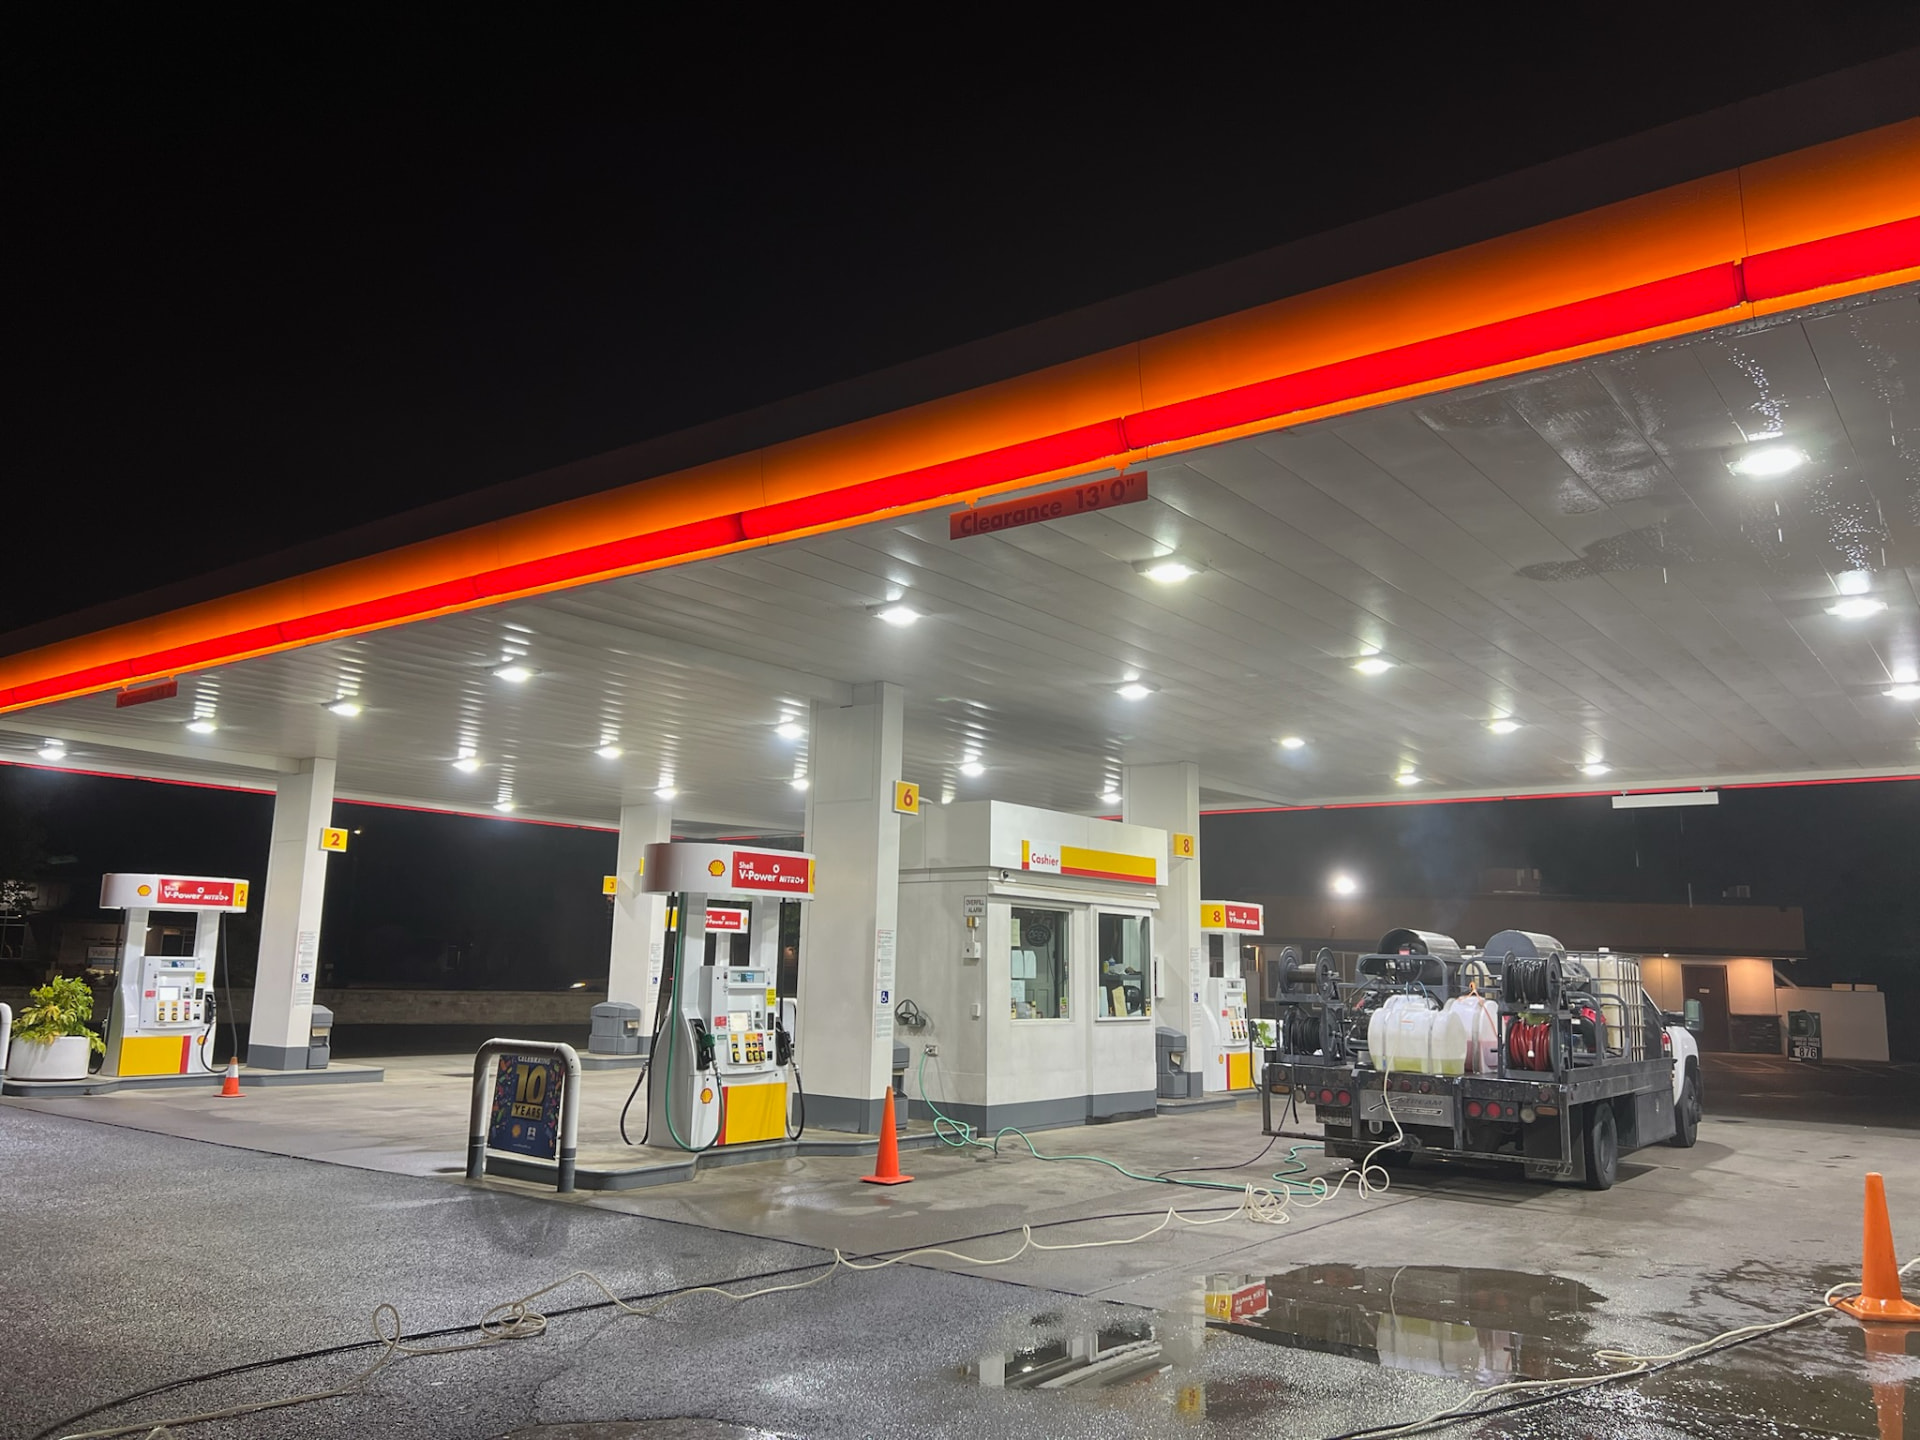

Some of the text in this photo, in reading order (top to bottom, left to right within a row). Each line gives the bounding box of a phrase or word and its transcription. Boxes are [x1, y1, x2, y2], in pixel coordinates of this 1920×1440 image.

[960, 501, 1062, 534] Clearance
[1075, 485, 1105, 509] 13'
[903, 788, 913, 807] 6
[331, 832, 340, 846] 2
[1184, 839, 1190, 853] 8
[738, 861, 754, 869] Shell
[1031, 852, 1059, 866] Cashier
[738, 869, 777, 882] V-Power
[164, 892, 202, 900] V-Power
[239, 890, 245, 902] 2
[1213, 910, 1221, 923] 8
[516, 1065, 547, 1104] 10
[514, 1105, 542, 1119] YEARS
